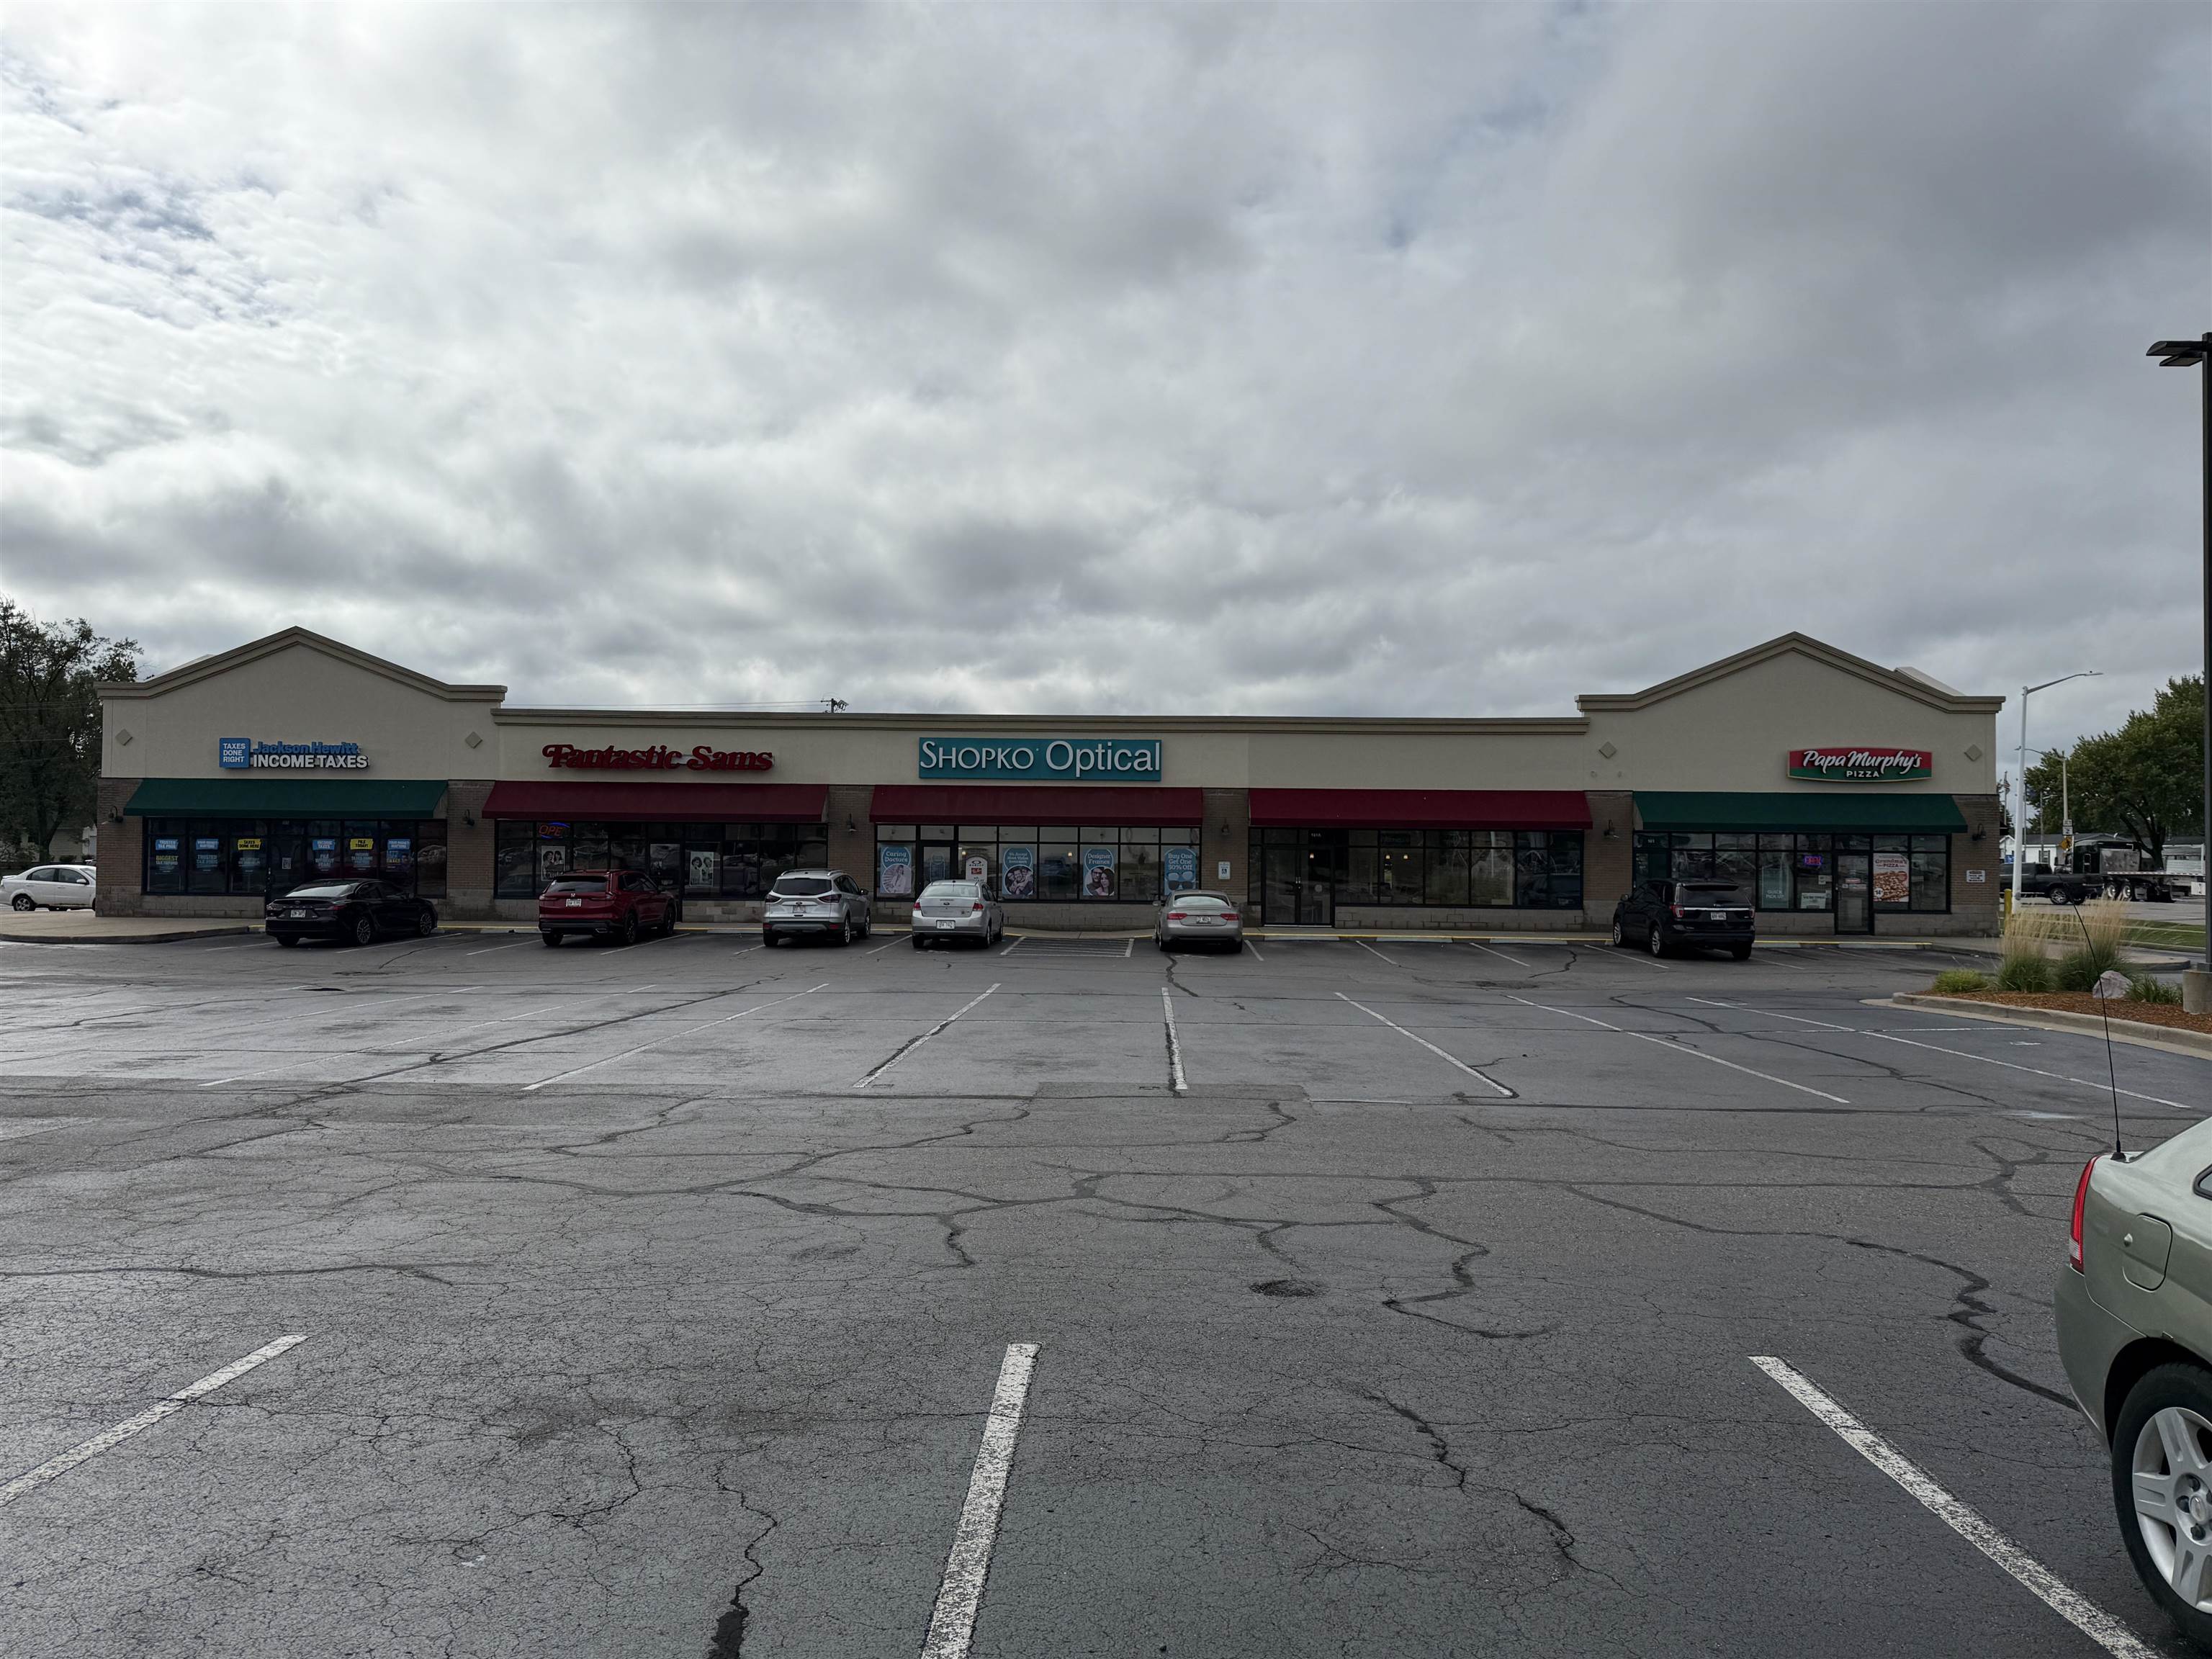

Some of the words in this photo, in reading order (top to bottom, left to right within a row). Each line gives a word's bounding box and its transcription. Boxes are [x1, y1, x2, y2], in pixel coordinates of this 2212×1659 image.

[253, 741, 311, 755] Jackson
[311, 742, 359, 755] Hewitt
[541, 744, 682, 770] Fantastic
[688, 745, 773, 771] Sams
[253, 755, 315, 768] INCOME
[316, 755, 369, 768] TAXES
[920, 740, 1035, 770] SHOPKO
[1045, 740, 1161, 778] Optical
[1803, 750, 1848, 773] Papa
[1846, 750, 1923, 775] Murphy's
[538, 824, 565, 837] OPE
